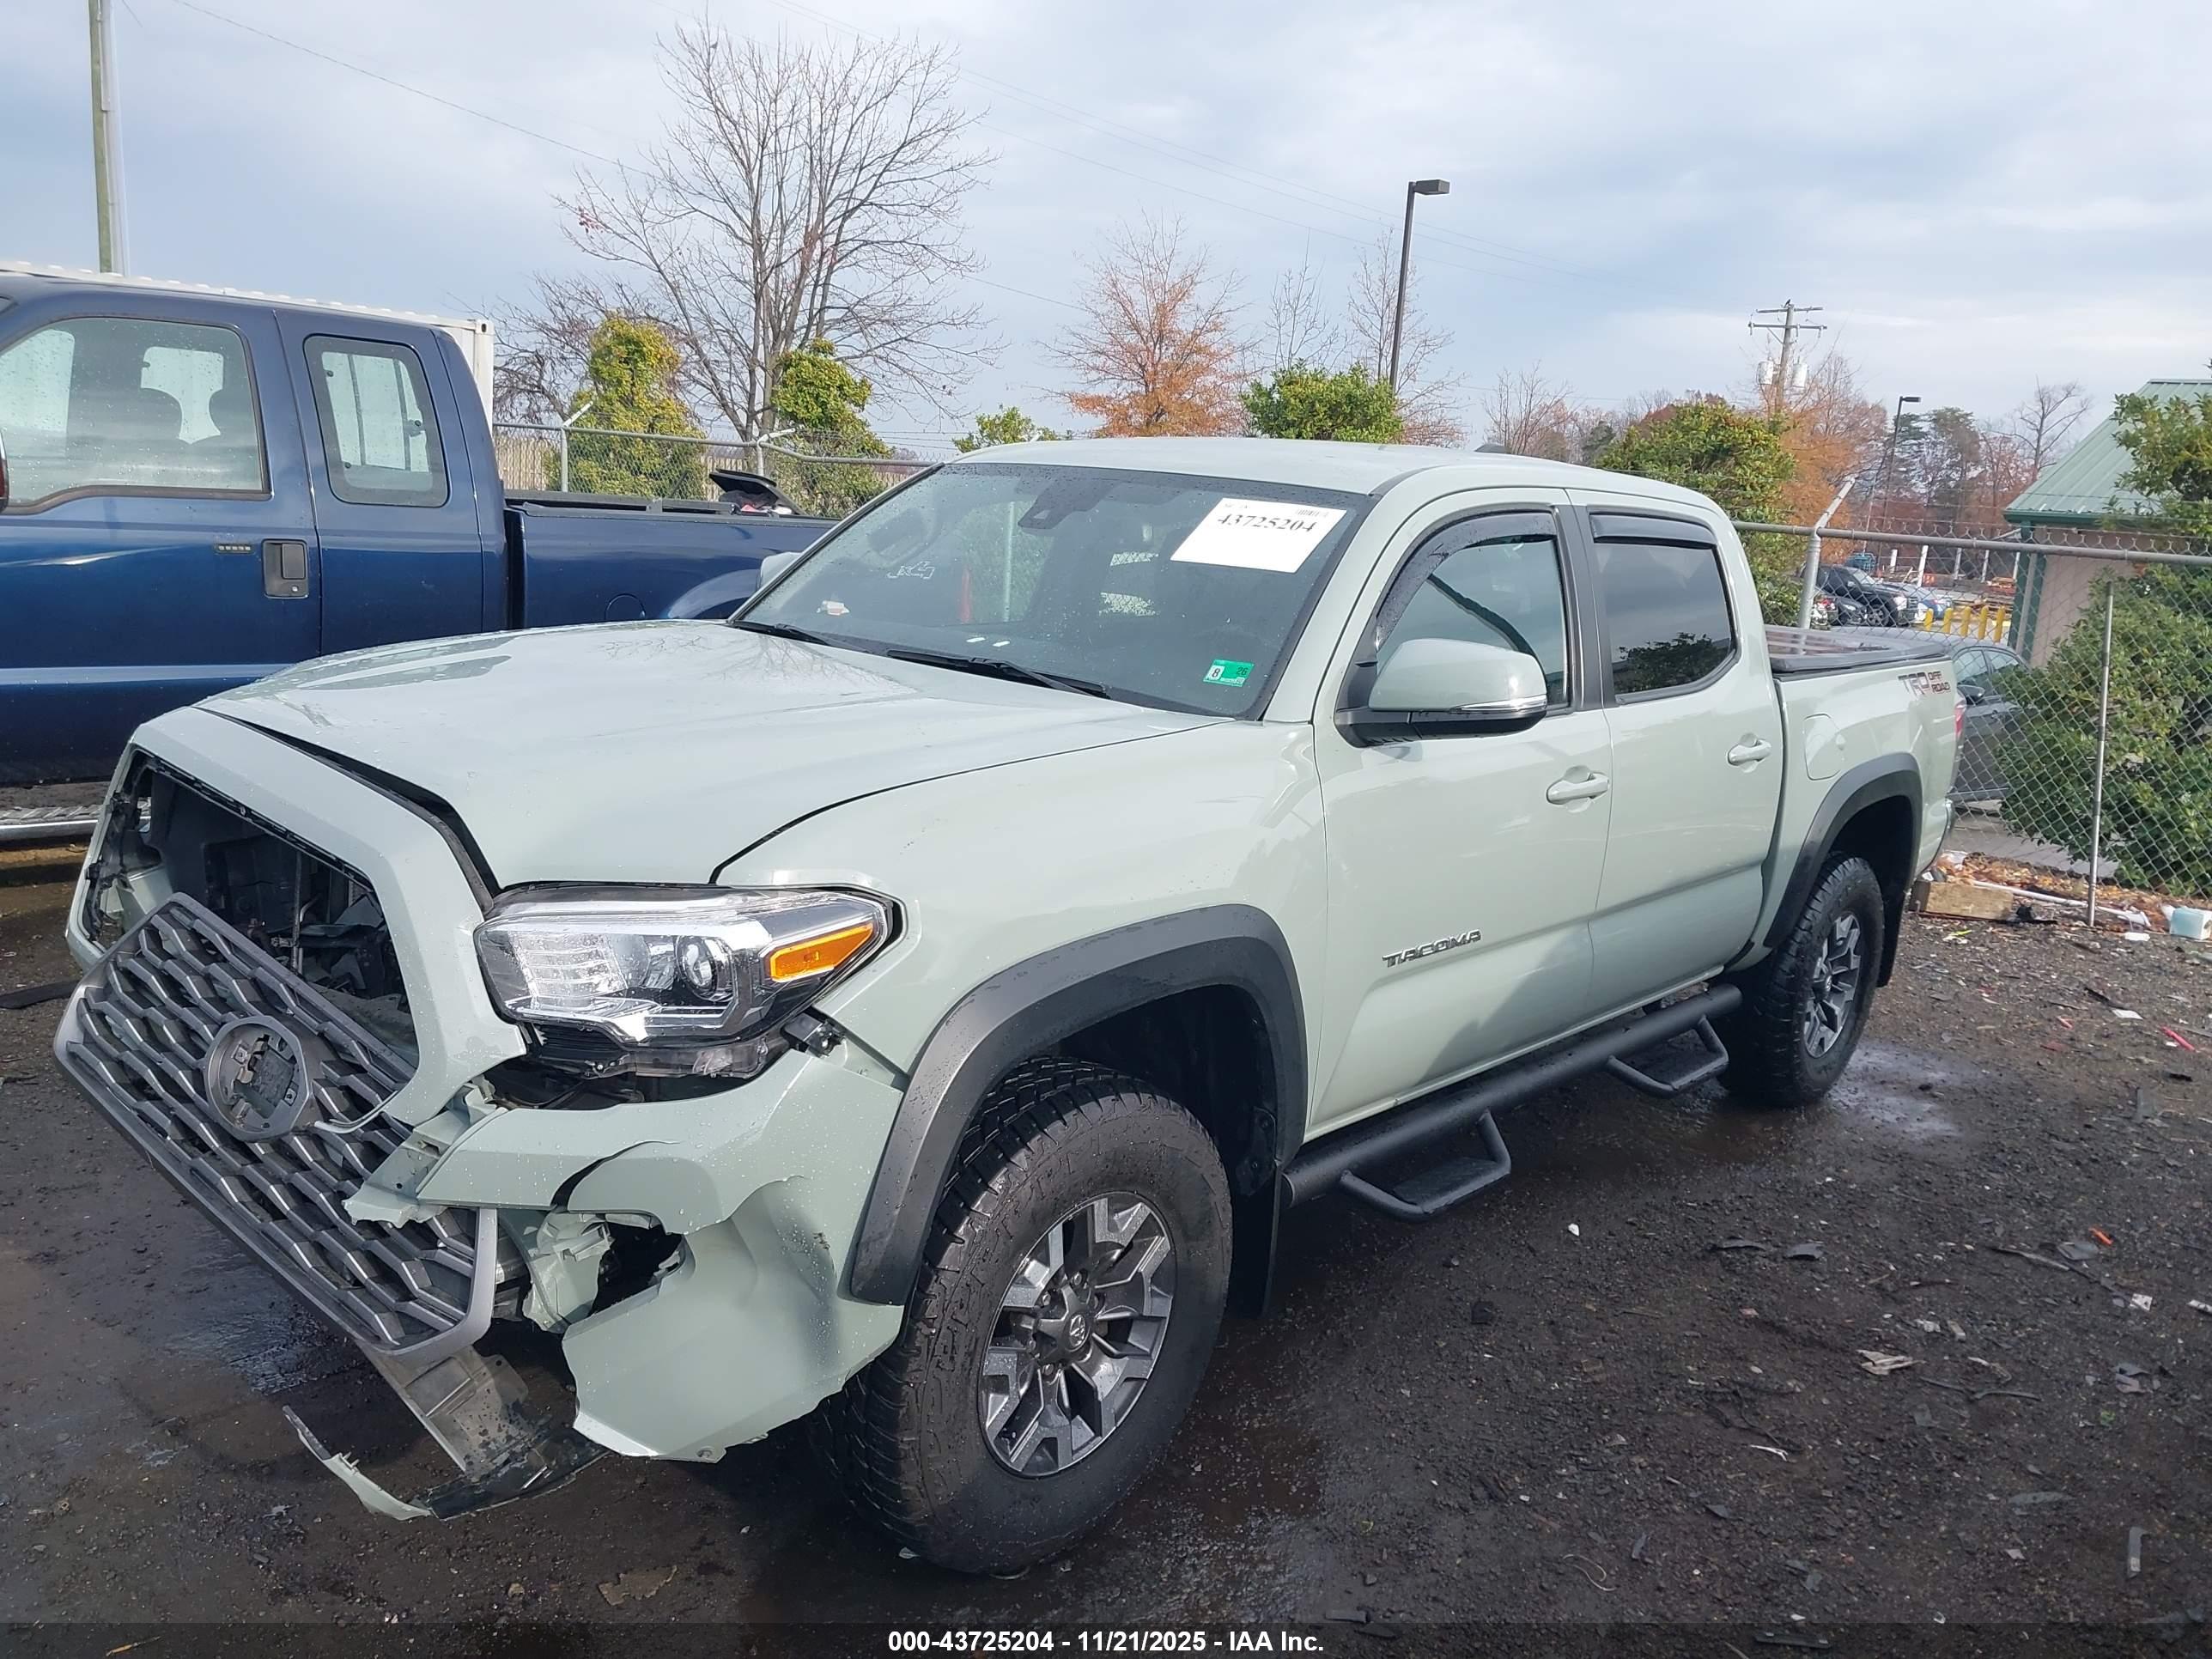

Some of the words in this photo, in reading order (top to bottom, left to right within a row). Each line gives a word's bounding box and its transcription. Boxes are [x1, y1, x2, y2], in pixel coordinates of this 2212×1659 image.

[1218, 514, 1317, 532] 43725204
[1212, 667, 1221, 678] 8
[1898, 672, 1930, 696] TRD
[1931, 682, 1951, 694] ROAD
[1382, 929, 1481, 968] TACOMA
